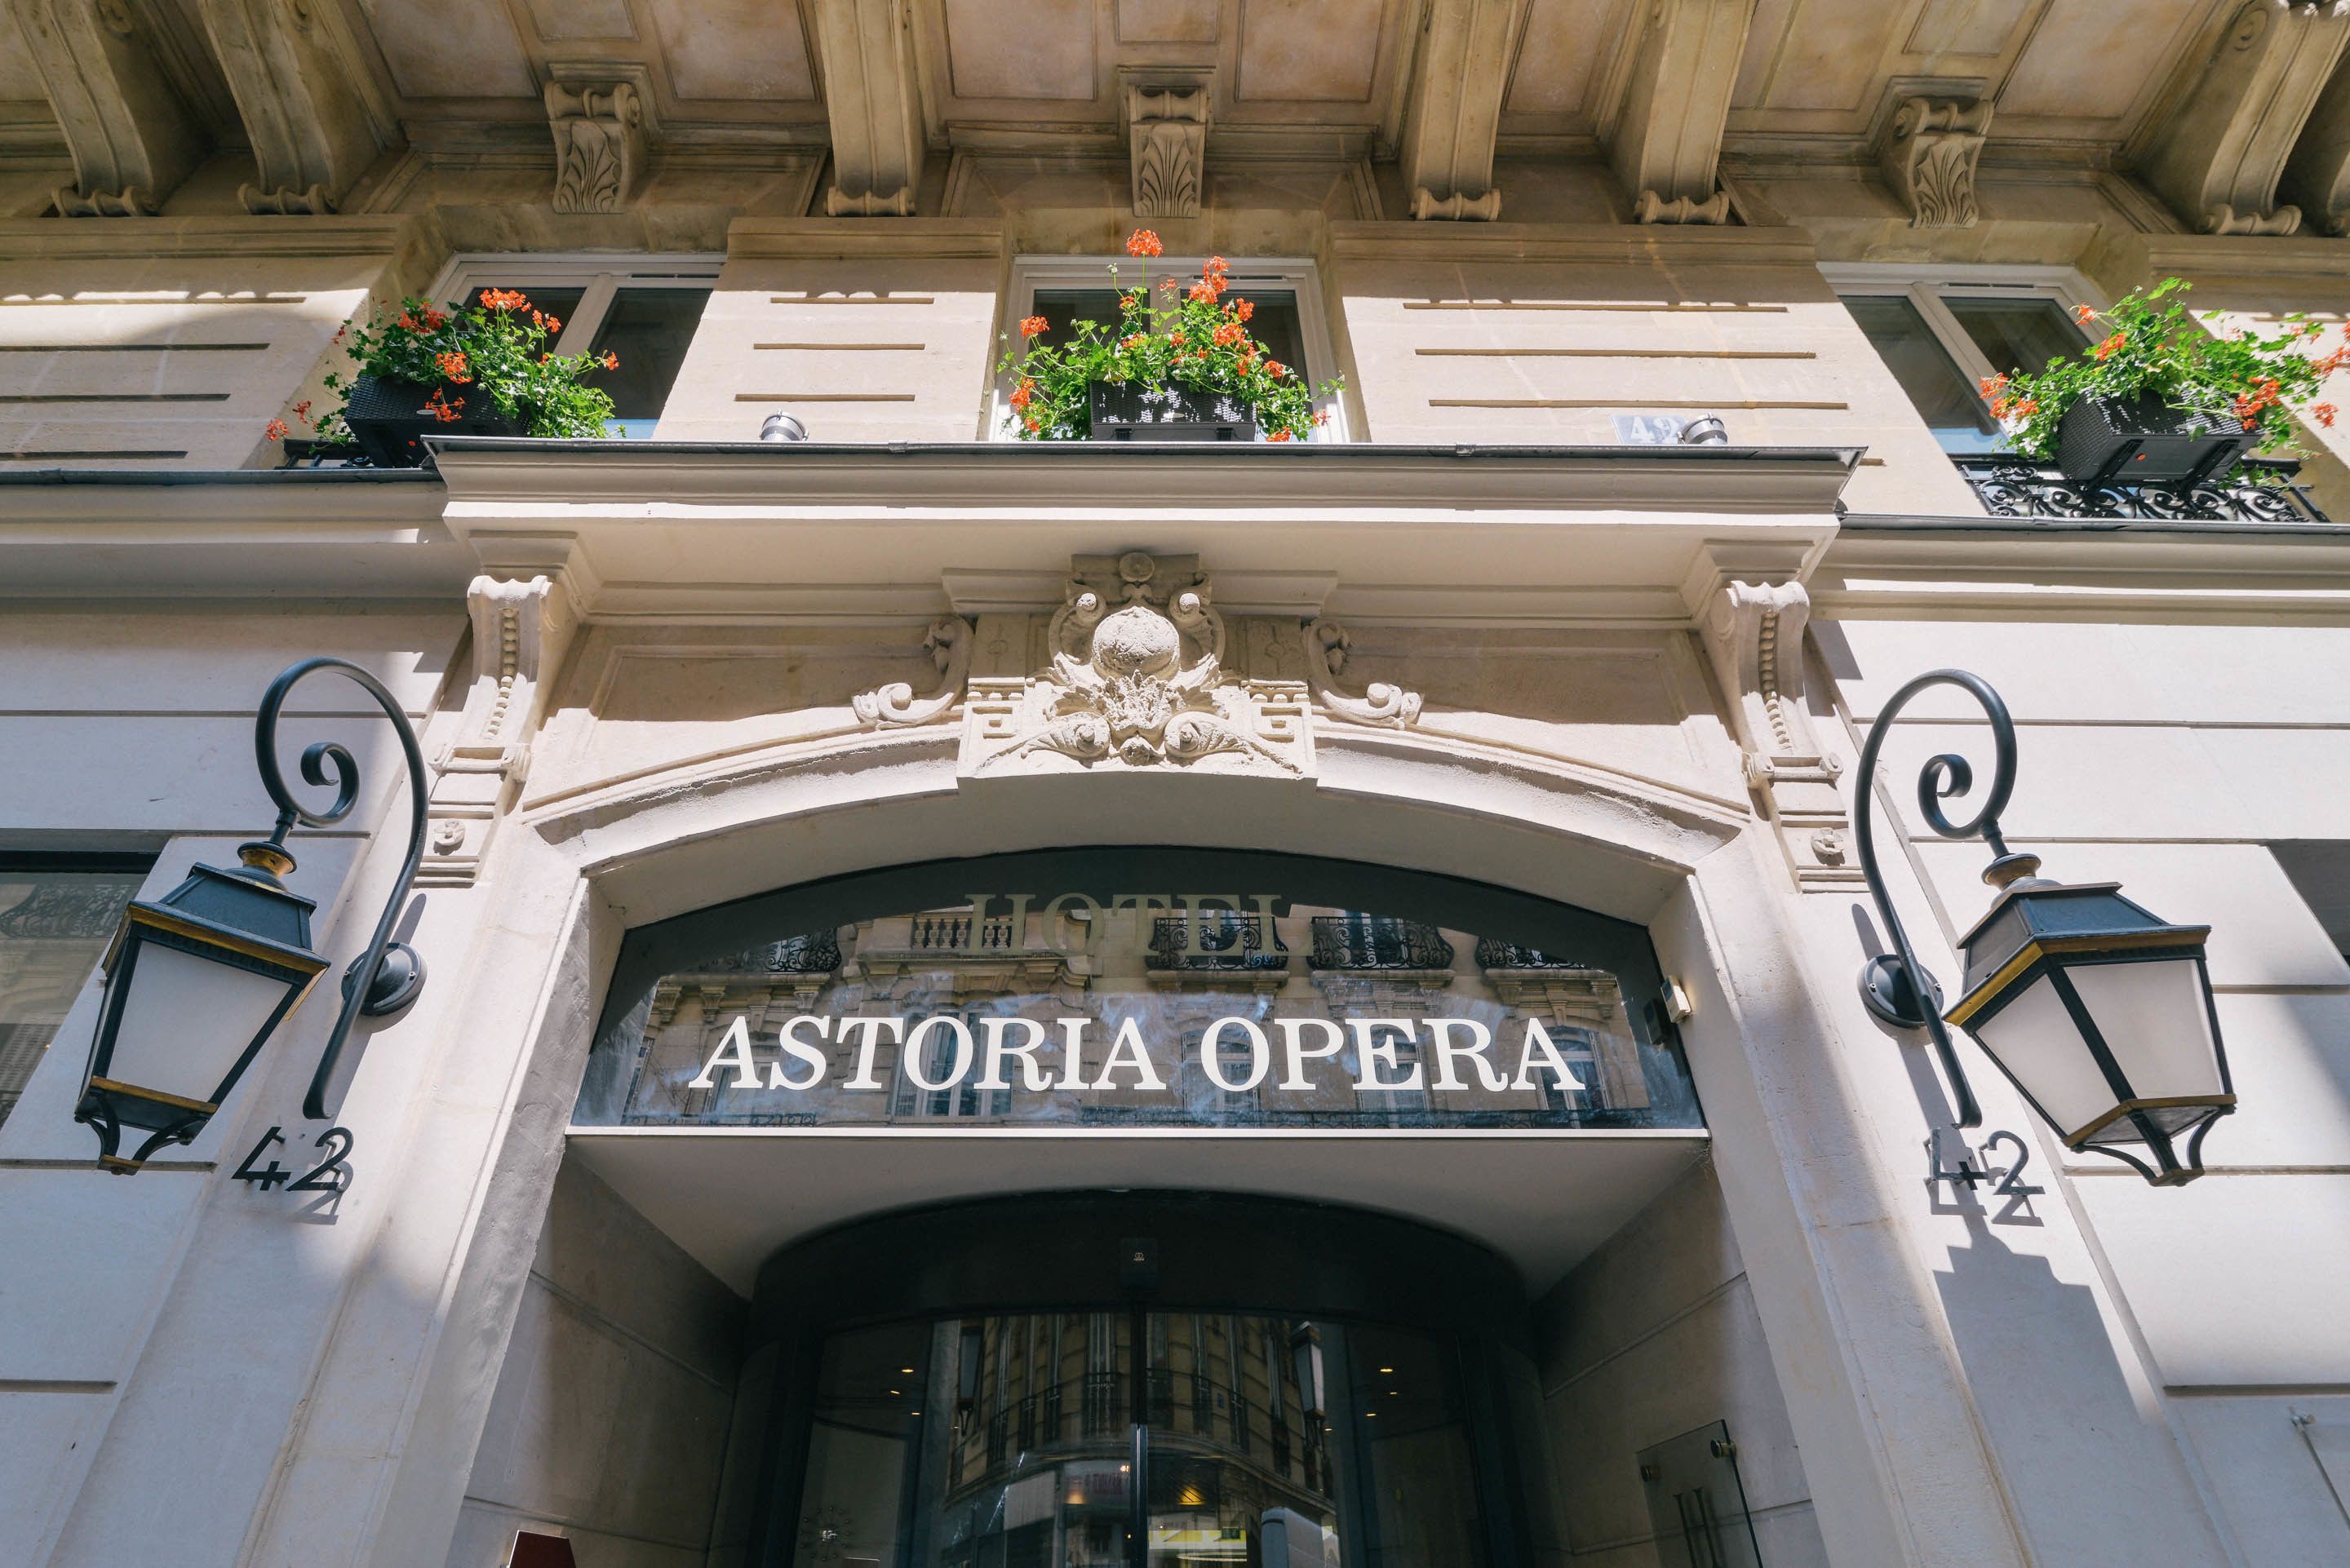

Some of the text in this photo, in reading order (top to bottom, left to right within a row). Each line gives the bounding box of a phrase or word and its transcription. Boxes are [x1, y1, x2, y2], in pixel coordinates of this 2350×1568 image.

[957, 893, 1314, 957] HOTEL
[689, 1016, 1585, 1091] ASTORIA OPERA
[232, 1127, 354, 1191] 42
[1929, 1126, 2046, 1195] 42
